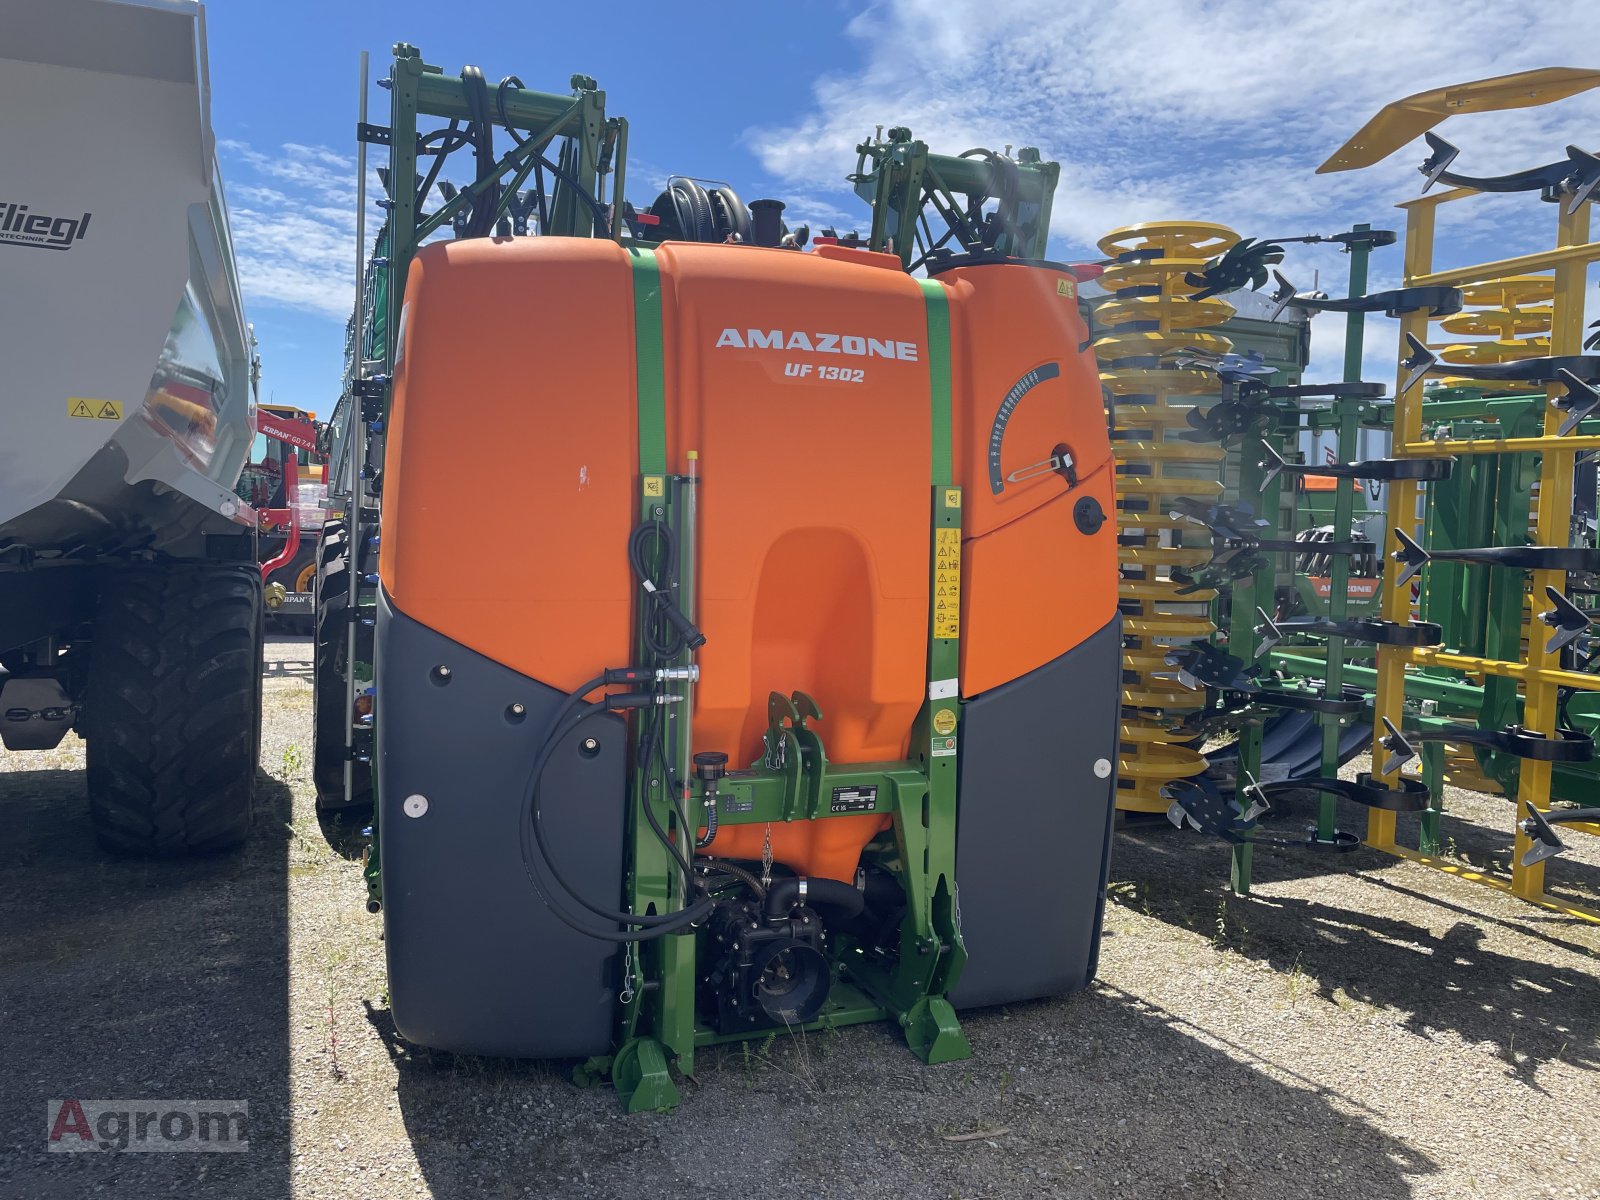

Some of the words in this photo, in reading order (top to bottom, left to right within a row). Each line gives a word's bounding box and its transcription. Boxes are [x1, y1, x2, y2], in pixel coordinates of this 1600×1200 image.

[715, 328, 919, 361] AMAZONE
[784, 363, 812, 377] UF
[818, 366, 865, 383] 1302
